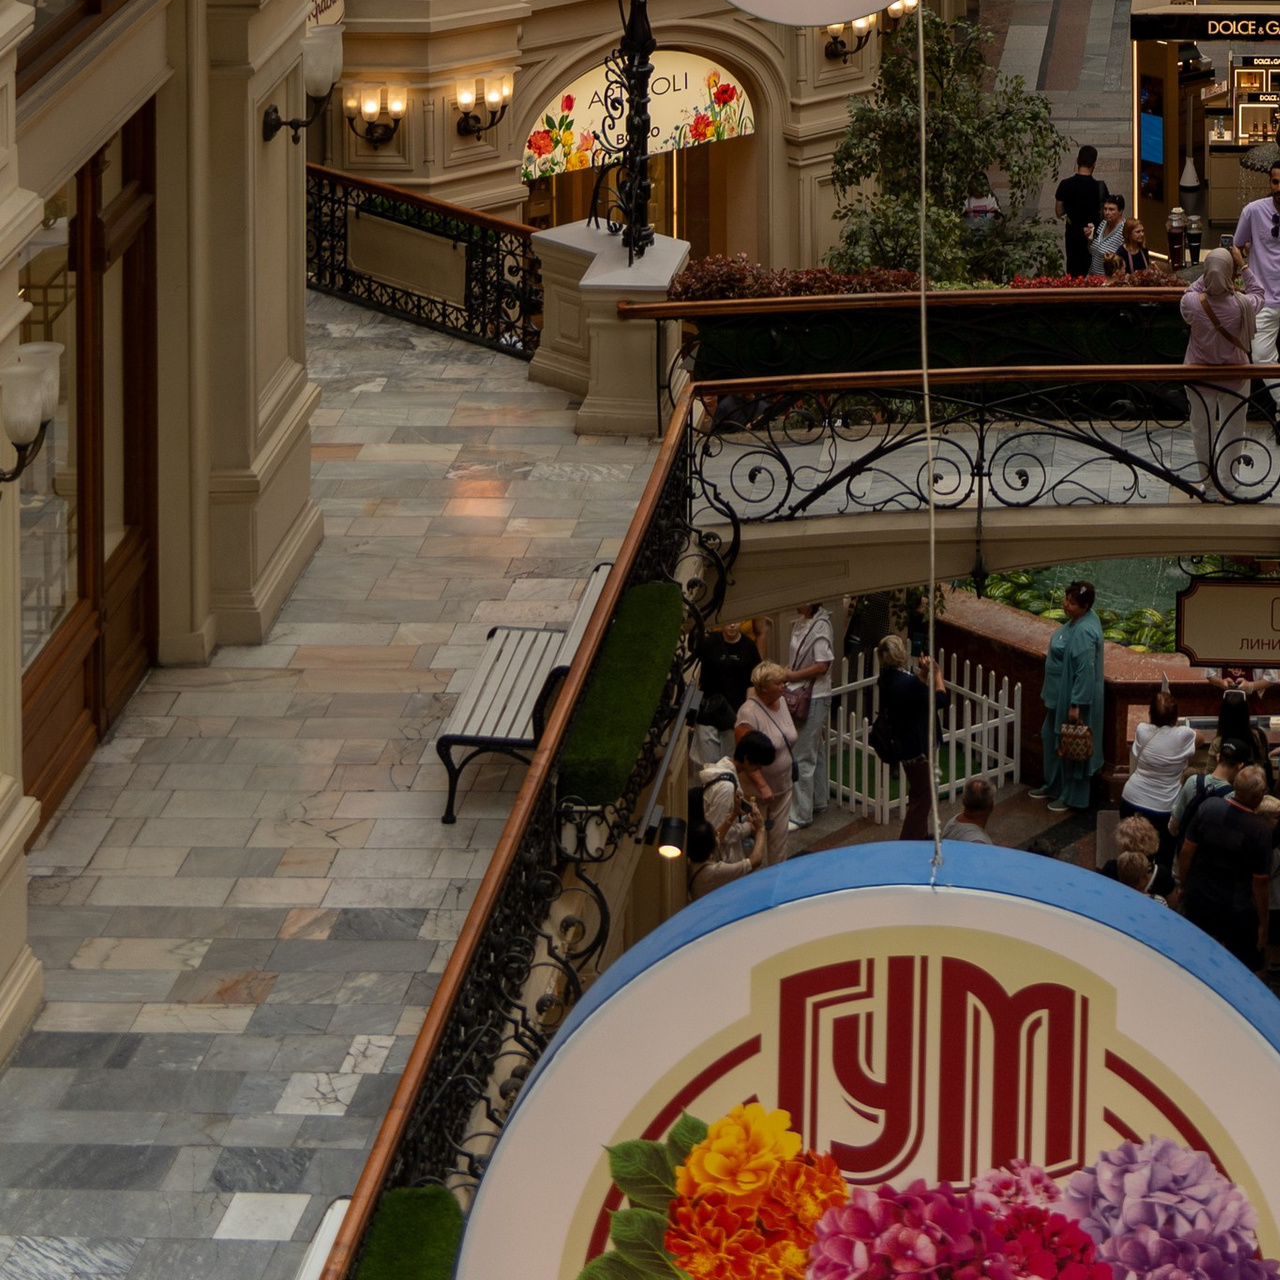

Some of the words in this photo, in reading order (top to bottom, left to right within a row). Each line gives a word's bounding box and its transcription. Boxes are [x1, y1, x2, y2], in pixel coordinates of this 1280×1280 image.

[1208, 20, 1256, 35] DOLCE
[588, 72, 688, 110] ARTOLI
[777, 954, 1090, 1191] ГУМ
